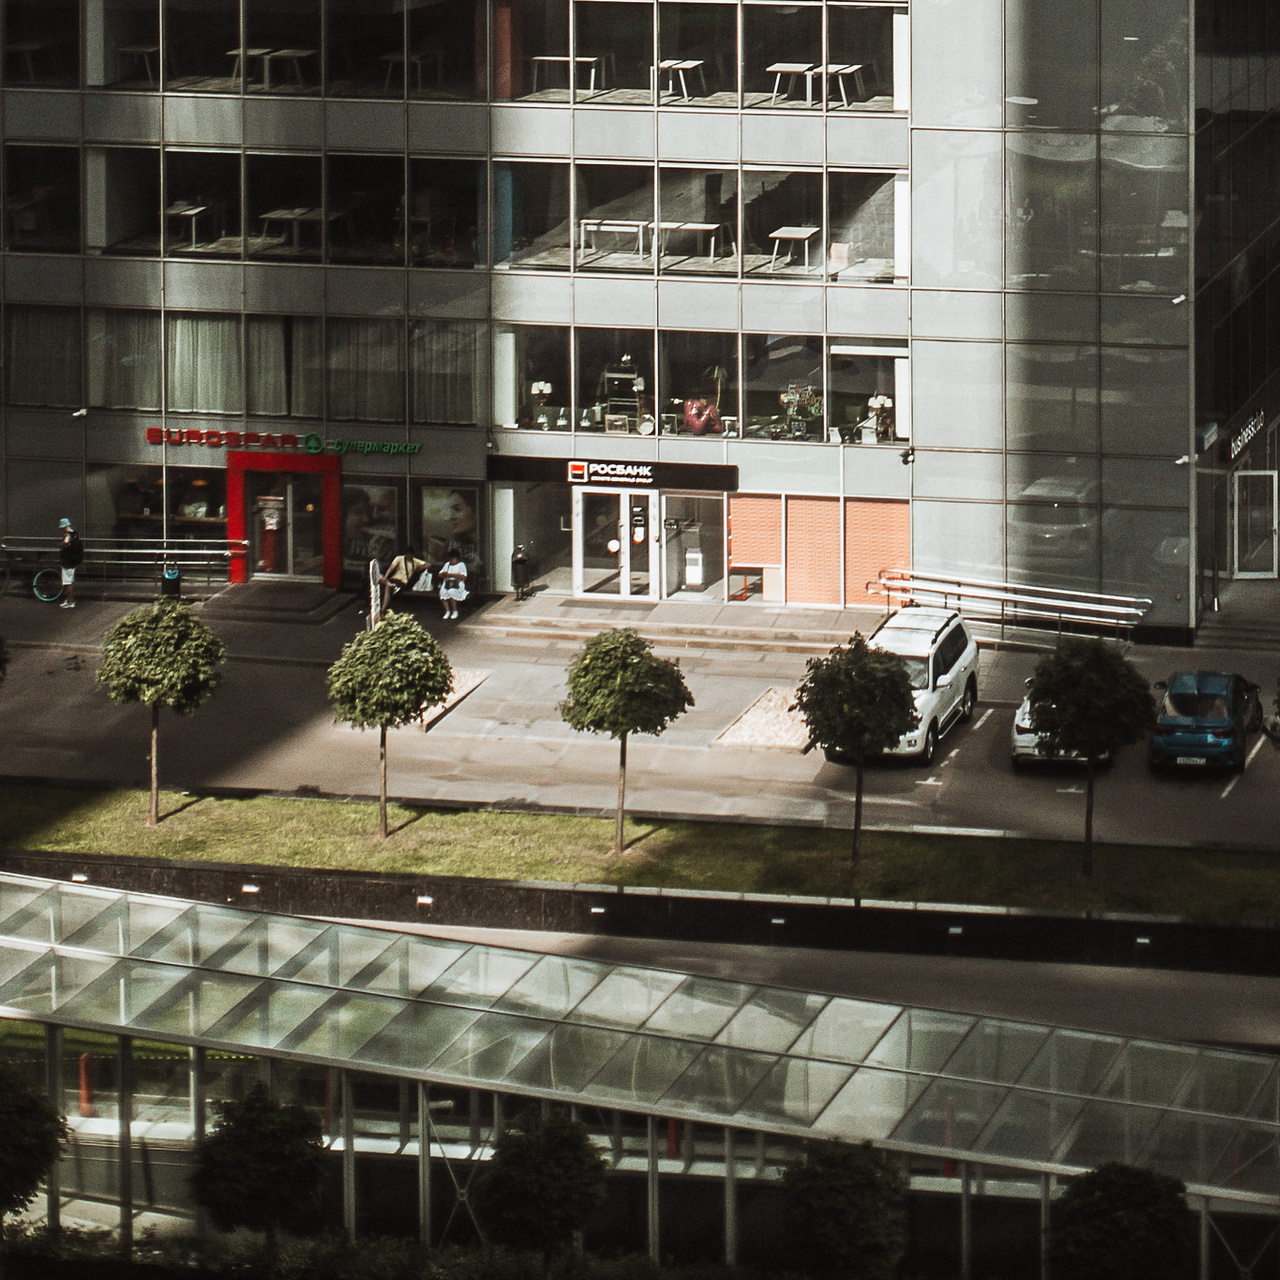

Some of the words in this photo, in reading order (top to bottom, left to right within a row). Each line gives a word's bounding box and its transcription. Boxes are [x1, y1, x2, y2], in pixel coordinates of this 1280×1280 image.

[145, 426, 298, 447] EUROSPAR
[333, 437, 422, 455] Супермаркет
[589, 463, 652, 477] РОСБАНК
